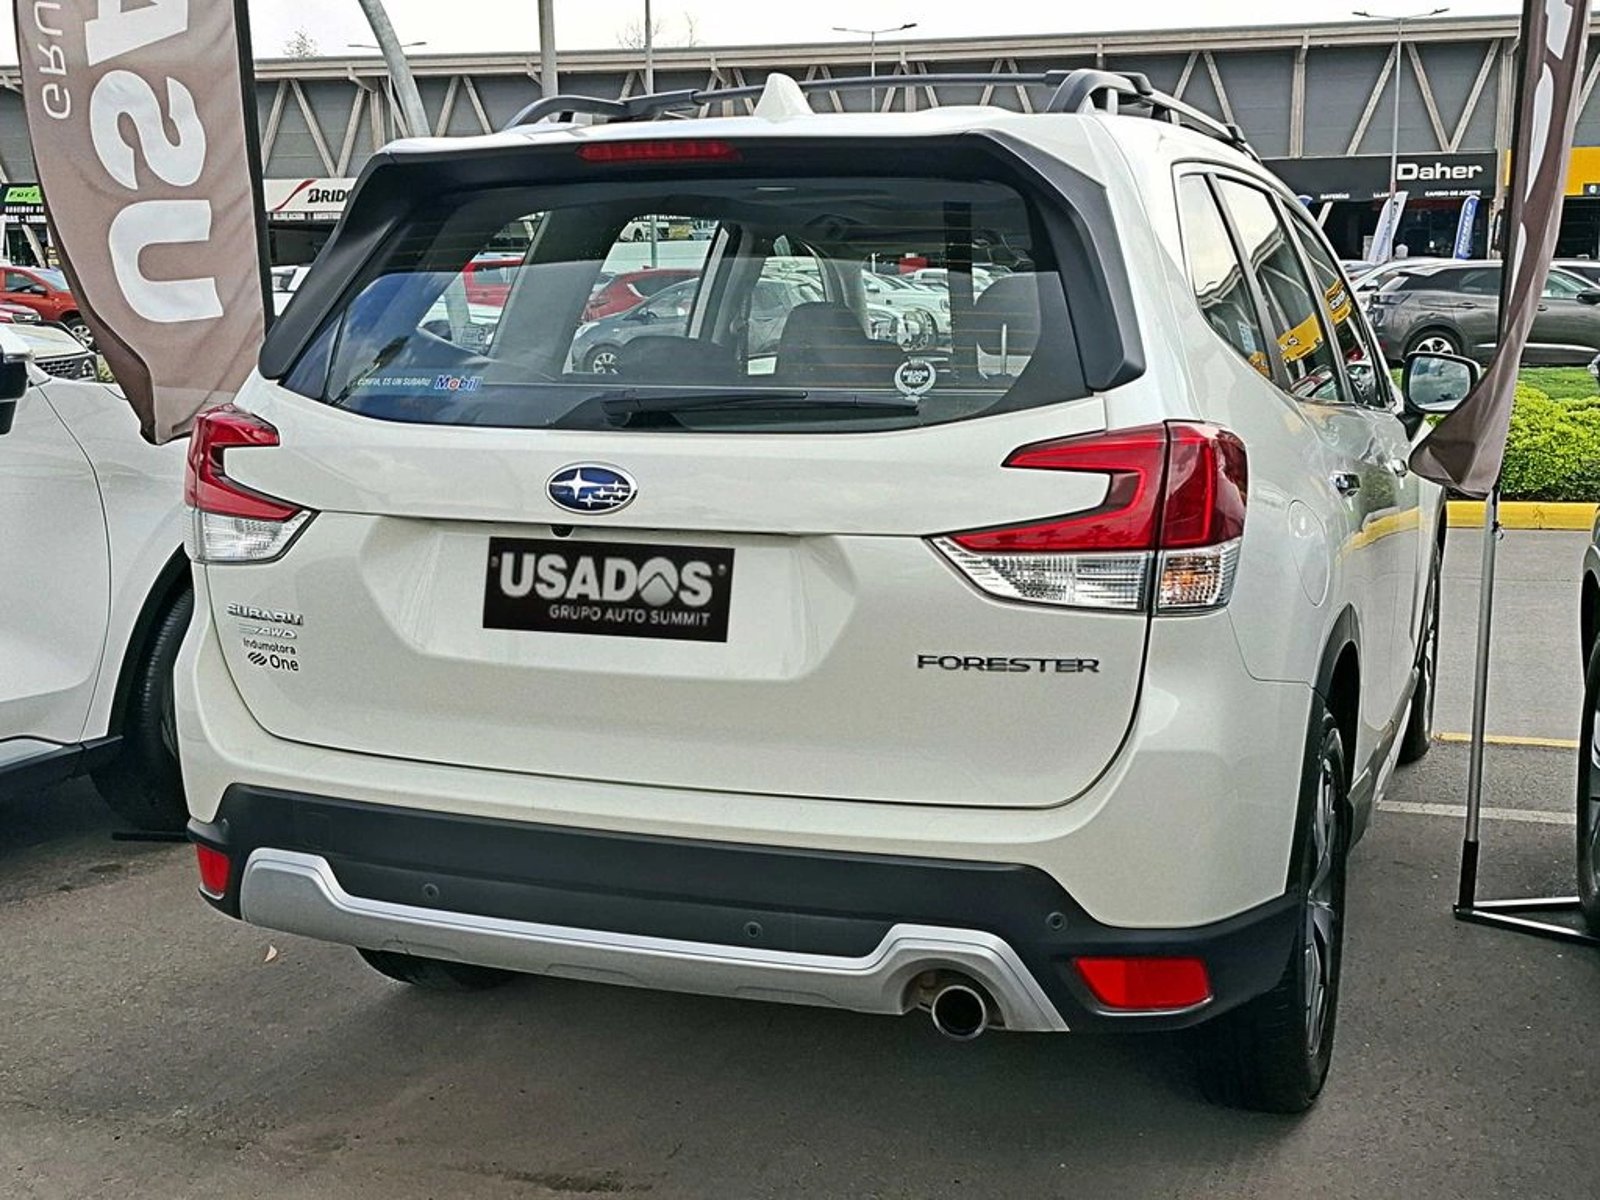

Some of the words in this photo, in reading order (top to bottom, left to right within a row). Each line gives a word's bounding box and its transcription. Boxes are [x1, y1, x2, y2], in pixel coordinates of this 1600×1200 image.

[1396, 162, 1483, 180] Daher
[307, 188, 352, 203] BRID
[434, 374, 482, 391] Mobil
[499, 551, 713, 607] USADOS
[226, 603, 304, 627] SUBARU
[549, 604, 600, 620] GRUPO
[605, 607, 647, 624] AUTO
[650, 609, 712, 626] SUMMIT
[269, 654, 299, 671] One
[917, 654, 1100, 673] FORESTER
